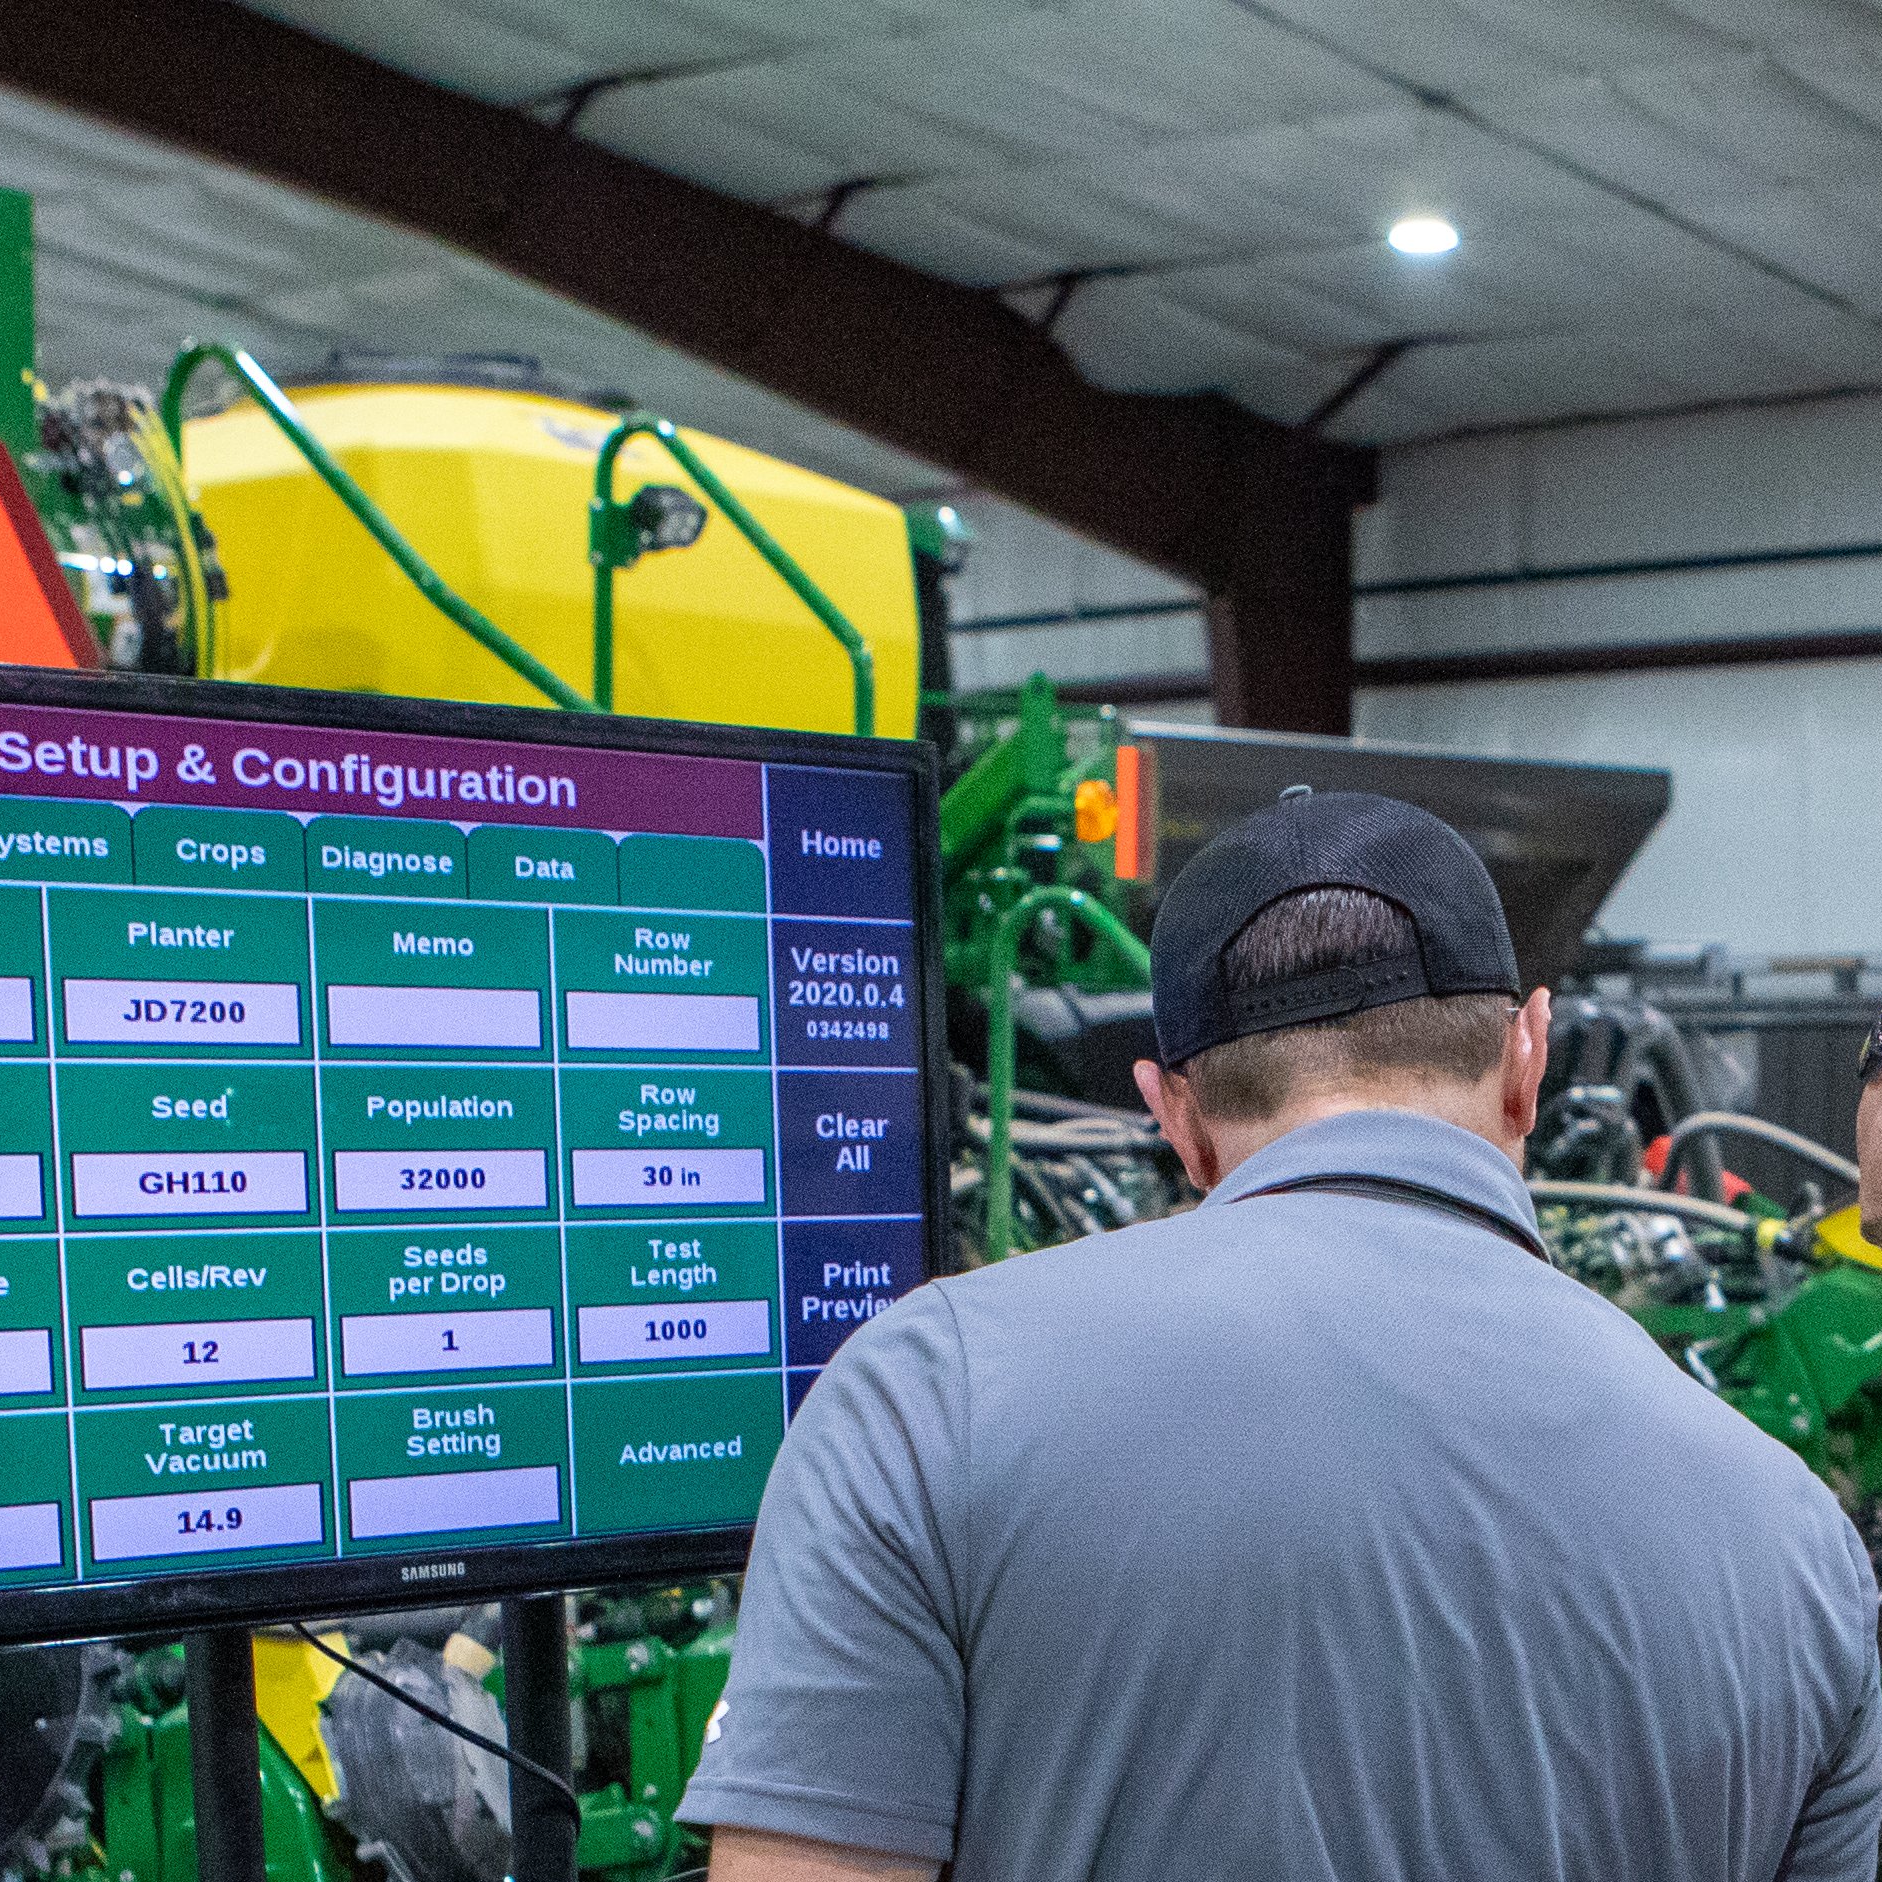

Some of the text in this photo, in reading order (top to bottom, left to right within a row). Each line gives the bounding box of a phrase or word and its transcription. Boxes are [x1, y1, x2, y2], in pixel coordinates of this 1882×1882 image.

[176, 744, 216, 783] &
[232, 747, 578, 807] Configuration
[175, 838, 266, 869] Crops
[801, 830, 881, 859] Home
[322, 845, 453, 877] Diagnose
[515, 856, 574, 880] Data
[128, 923, 233, 949] Planter
[393, 932, 474, 957] Memo
[634, 928, 690, 950] Row
[615, 953, 713, 977] Number
[791, 947, 898, 975] Version
[789, 981, 905, 1007] 2020.0.4
[123, 999, 245, 1024] JD7200
[807, 1021, 889, 1040] 0342498
[151, 1095, 228, 1119] Seed
[640, 1084, 695, 1106] Row
[367, 1096, 514, 1123] Population
[618, 1109, 719, 1135] Spacing
[816, 1115, 888, 1138] Clear
[836, 1146, 871, 1172] All
[139, 1171, 247, 1194] GH110
[400, 1168, 486, 1190] 32000
[642, 1166, 701, 1187] 30 in
[403, 1244, 488, 1268] Seeds
[648, 1239, 701, 1260] Test
[127, 1265, 266, 1291] Cells/Rev
[389, 1272, 506, 1300] per Drop
[631, 1263, 718, 1290] Length
[824, 1260, 891, 1287] Print
[802, 1293, 894, 1321] Previe
[441, 1330, 459, 1352] 1
[644, 1319, 708, 1342] 1000
[182, 1341, 219, 1365] 12
[412, 1404, 495, 1429] Brush
[158, 1419, 254, 1449] Target
[406, 1430, 502, 1458] Setting
[144, 1446, 267, 1475] Vacuum
[619, 1435, 742, 1465] Advanced
[177, 1507, 243, 1535] 14.9
[401, 1562, 466, 1582] SAMSUNG
